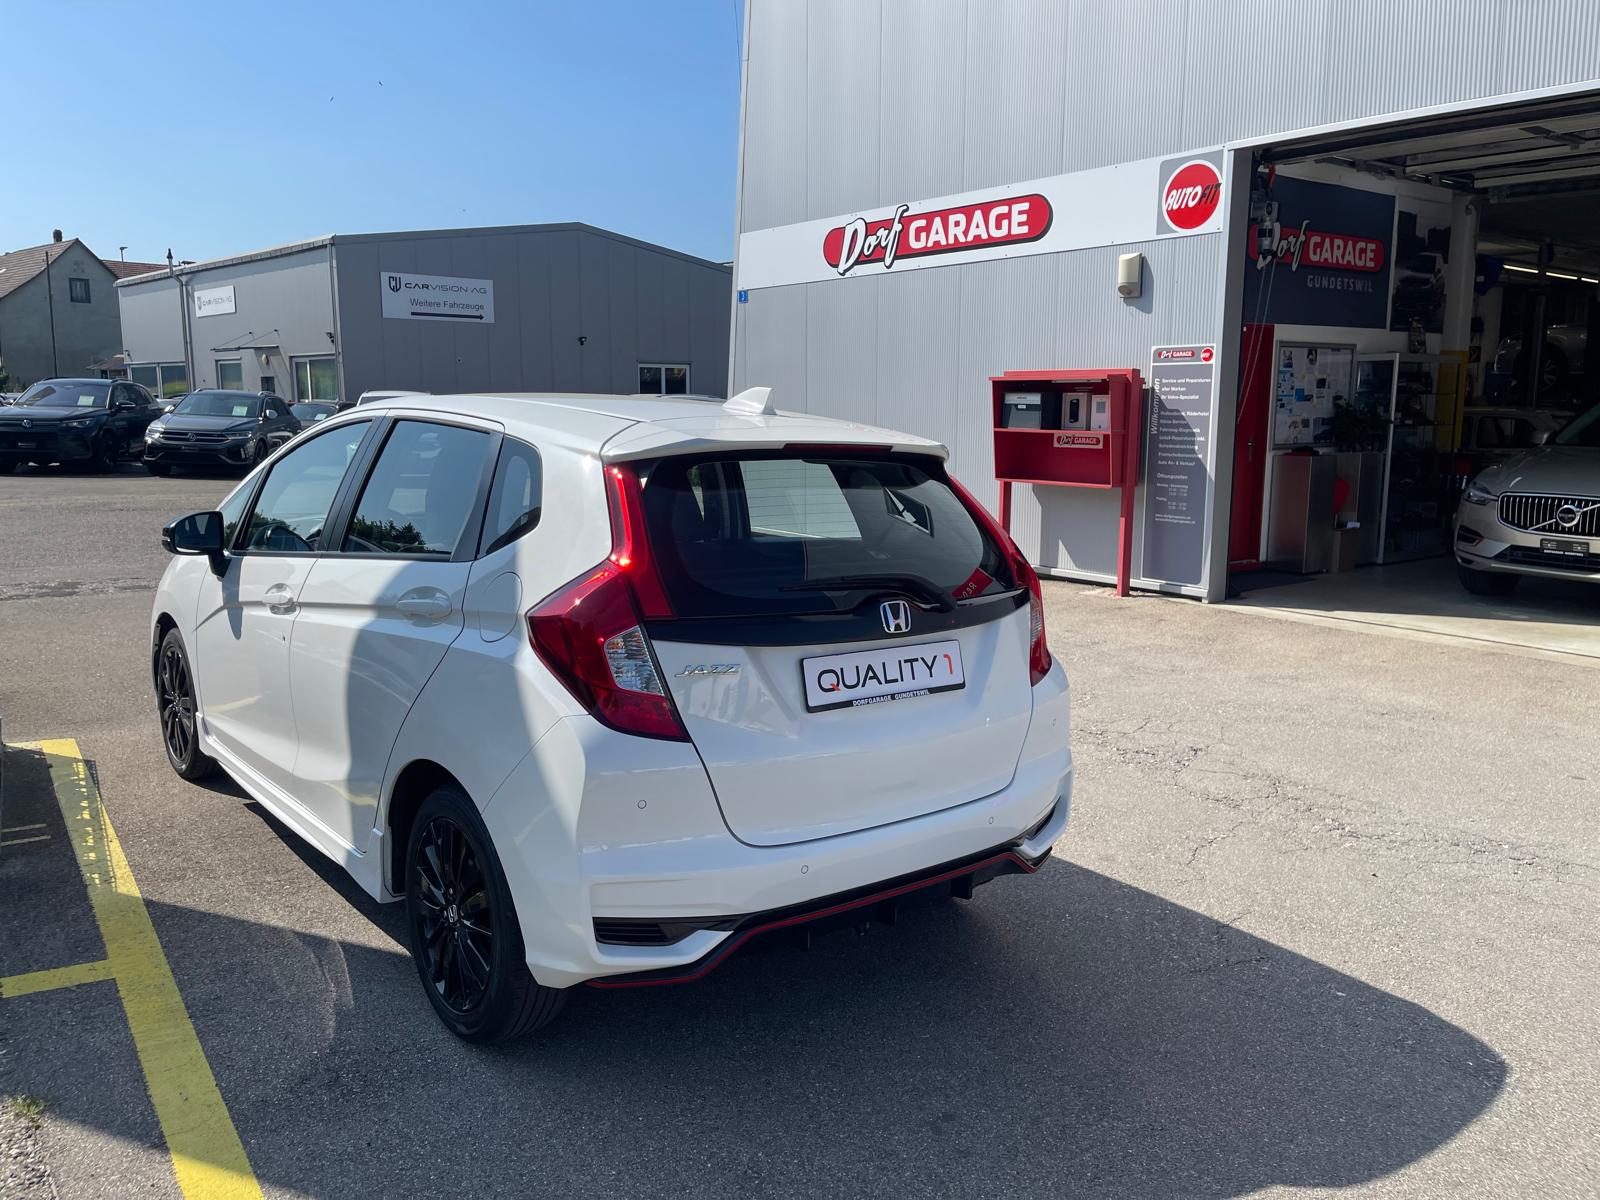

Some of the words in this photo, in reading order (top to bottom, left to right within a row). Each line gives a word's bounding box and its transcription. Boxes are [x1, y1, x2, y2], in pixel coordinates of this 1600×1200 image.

[1165, 182, 1221, 211] AUTOFIT
[837, 204, 909, 275] Dorf
[908, 201, 1030, 250] GARAGE
[1308, 235, 1376, 268] GARAGE
[404, 282, 468, 293] CARVISION
[1307, 274, 1373, 293] GUNDETSWIL
[410, 298, 441, 308] Weitere
[443, 300, 485, 312] Fahrzeuge
[675, 664, 741, 678] JAZZ
[816, 654, 938, 693] QUALITY
[943, 653, 954, 675] 1
[852, 694, 892, 707] DORFGARAGE
[894, 689, 930, 700] GUNDETSWIL
